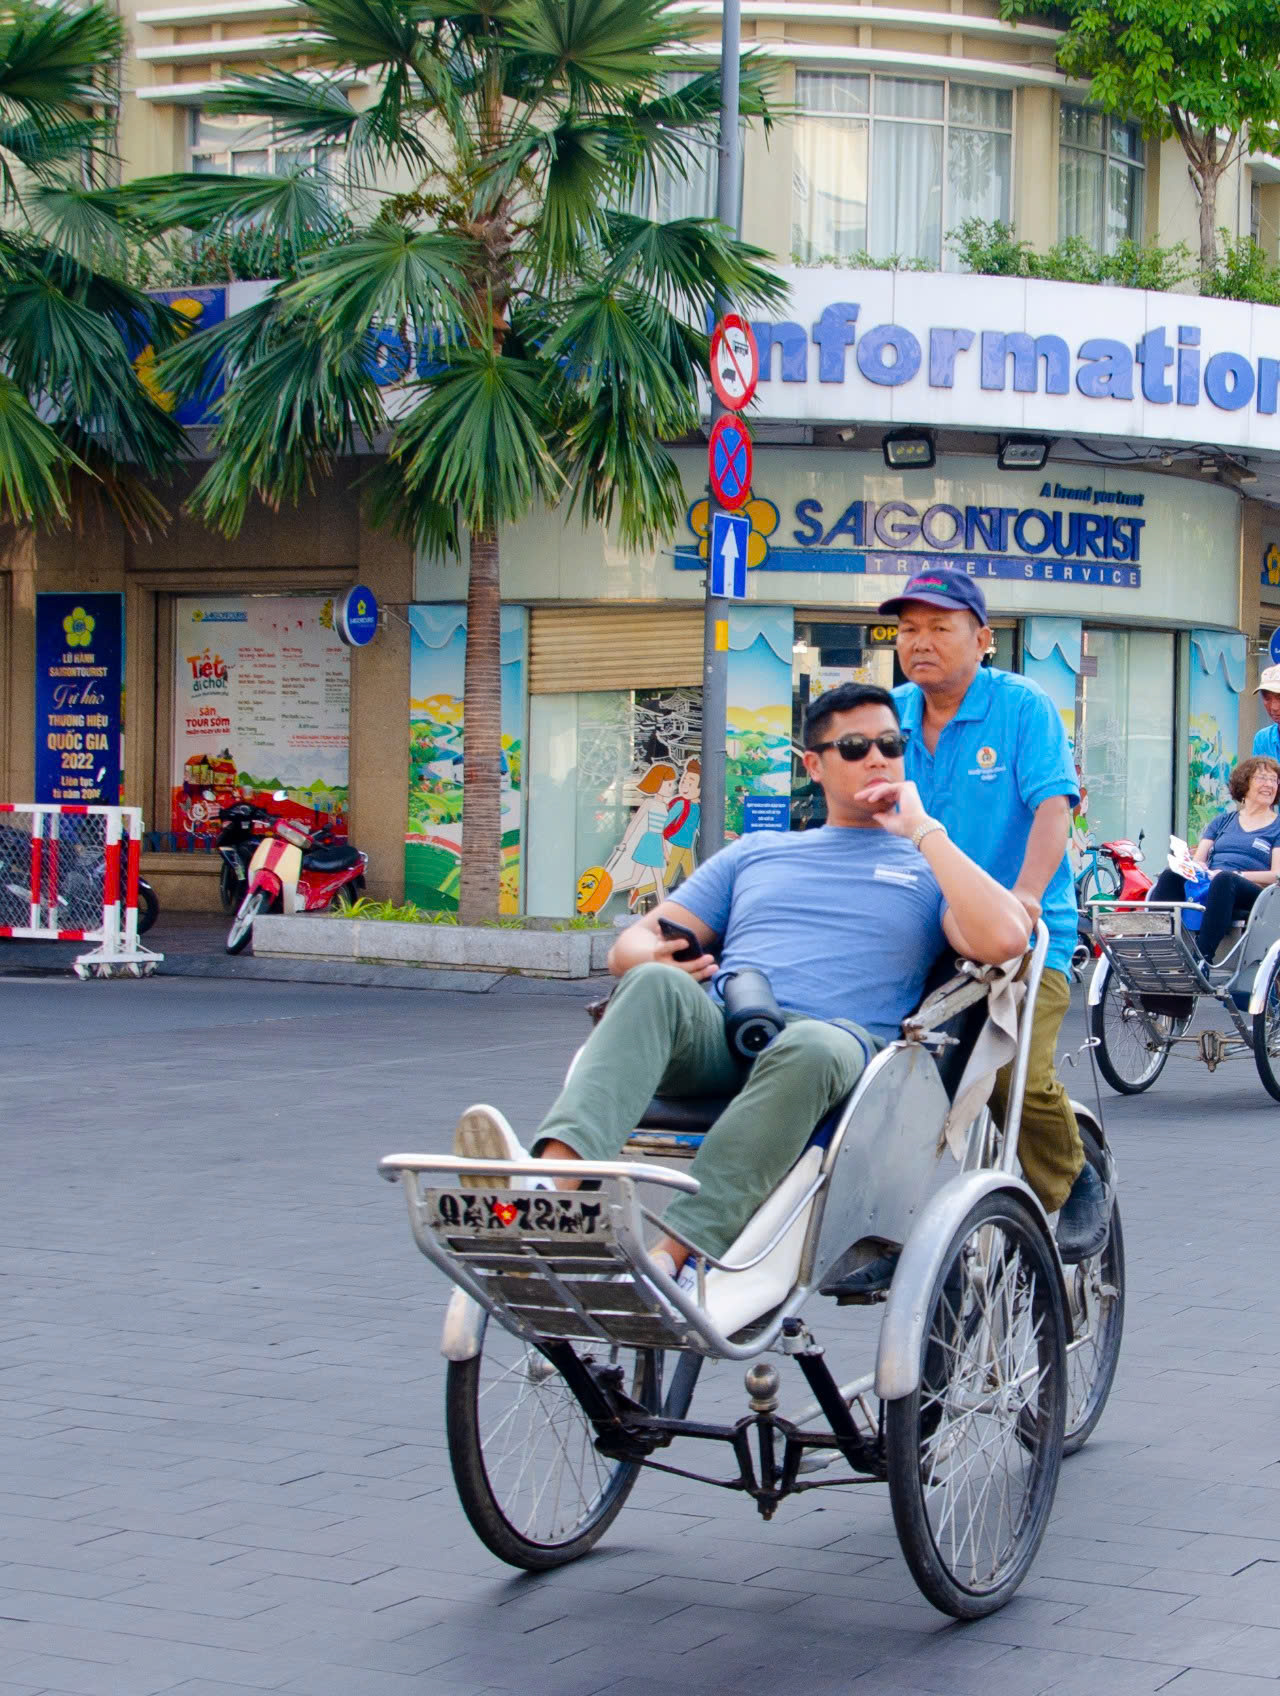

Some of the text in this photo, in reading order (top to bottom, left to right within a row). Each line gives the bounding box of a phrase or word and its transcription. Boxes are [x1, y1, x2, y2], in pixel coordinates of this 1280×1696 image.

[1039, 482, 1051, 497] A
[793, 499, 1145, 561] SAIGONTOURIST
[874, 558, 1137, 585] TRAVEL SERVICE
[873, 626, 898, 641] OP
[186, 648, 225, 680] Tết
[47, 729, 109, 751] QUỐC GIA
[61, 752, 94, 769] 2022
